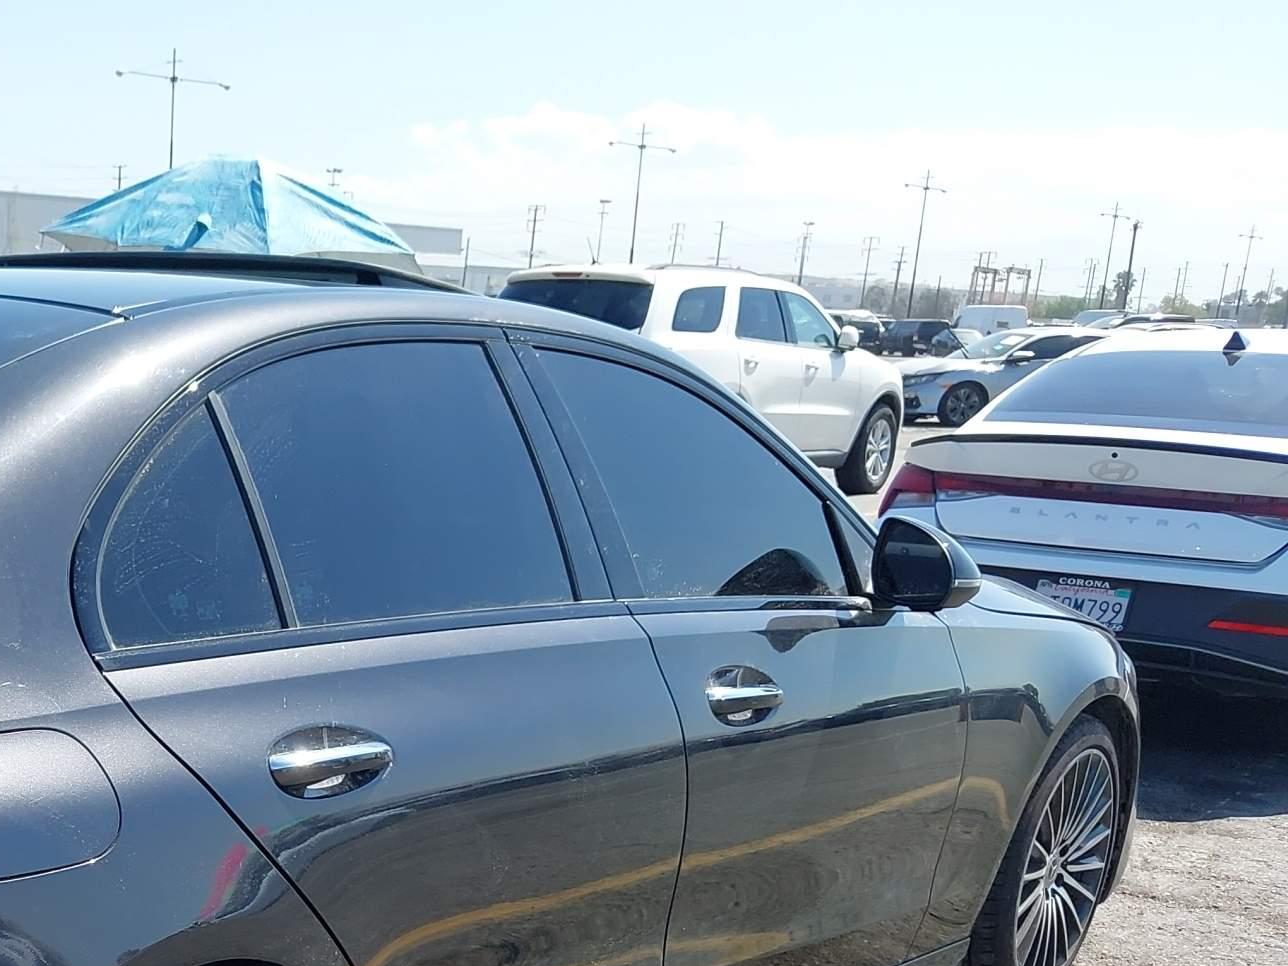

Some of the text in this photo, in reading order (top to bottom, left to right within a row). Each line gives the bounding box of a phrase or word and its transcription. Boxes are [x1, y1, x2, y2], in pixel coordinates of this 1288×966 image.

[1009, 506, 1200, 530] ELANTRA
[1059, 577, 1110, 589] CORONA
[1051, 596, 1123, 621] M799
